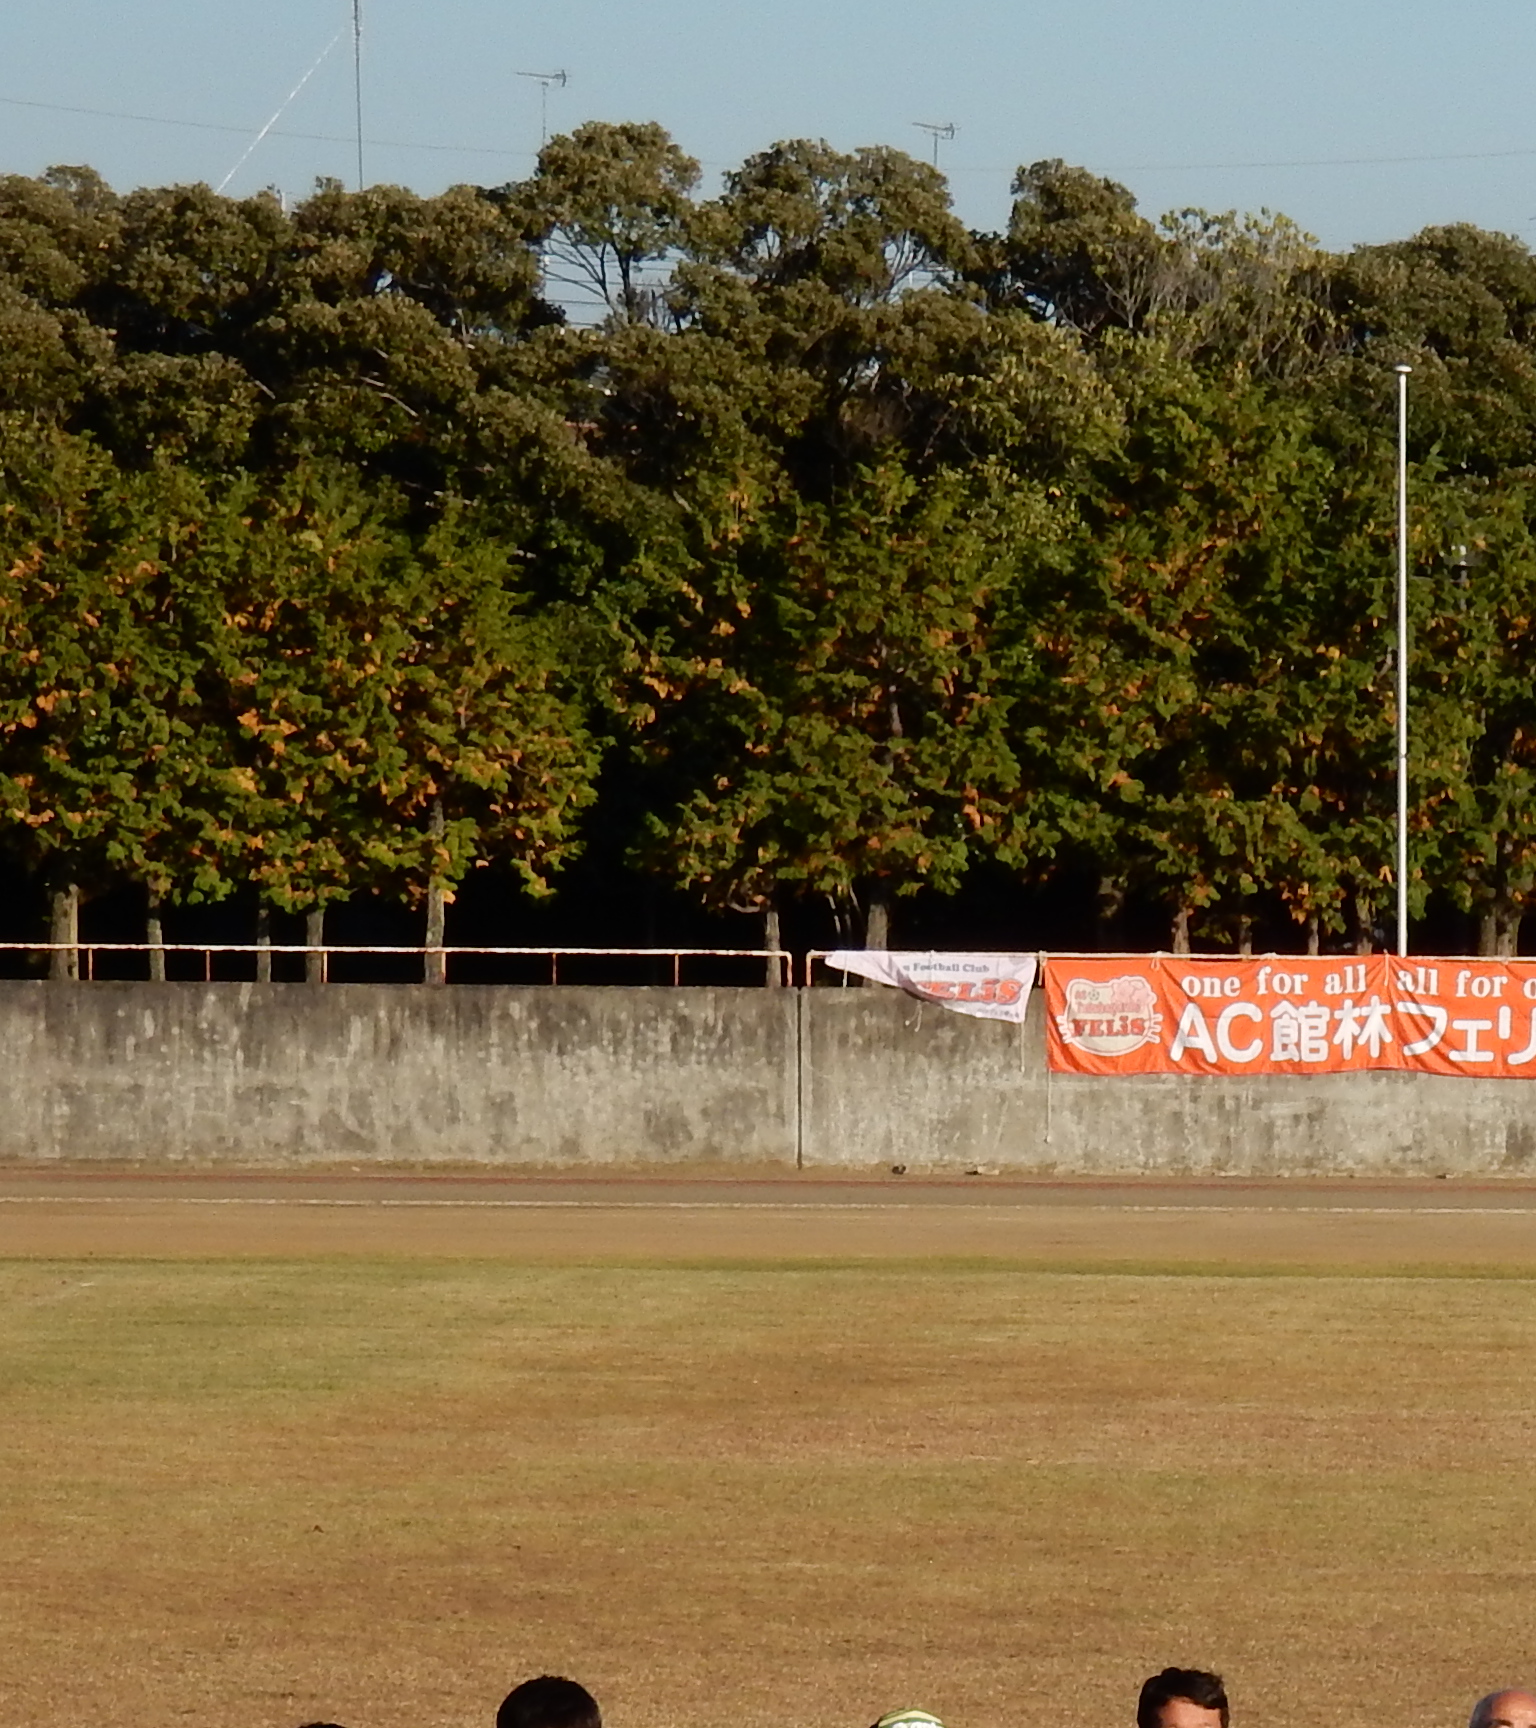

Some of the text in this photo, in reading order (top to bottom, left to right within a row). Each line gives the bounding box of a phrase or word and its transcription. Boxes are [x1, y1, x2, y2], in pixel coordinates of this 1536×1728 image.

[913, 962, 960, 973] Football
[962, 964, 990, 973] Club
[1181, 975, 1241, 998] one
[1256, 966, 1309, 996] for
[1324, 964, 1368, 995] all
[1397, 966, 1438, 996] all
[1456, 969, 1509, 998] for
